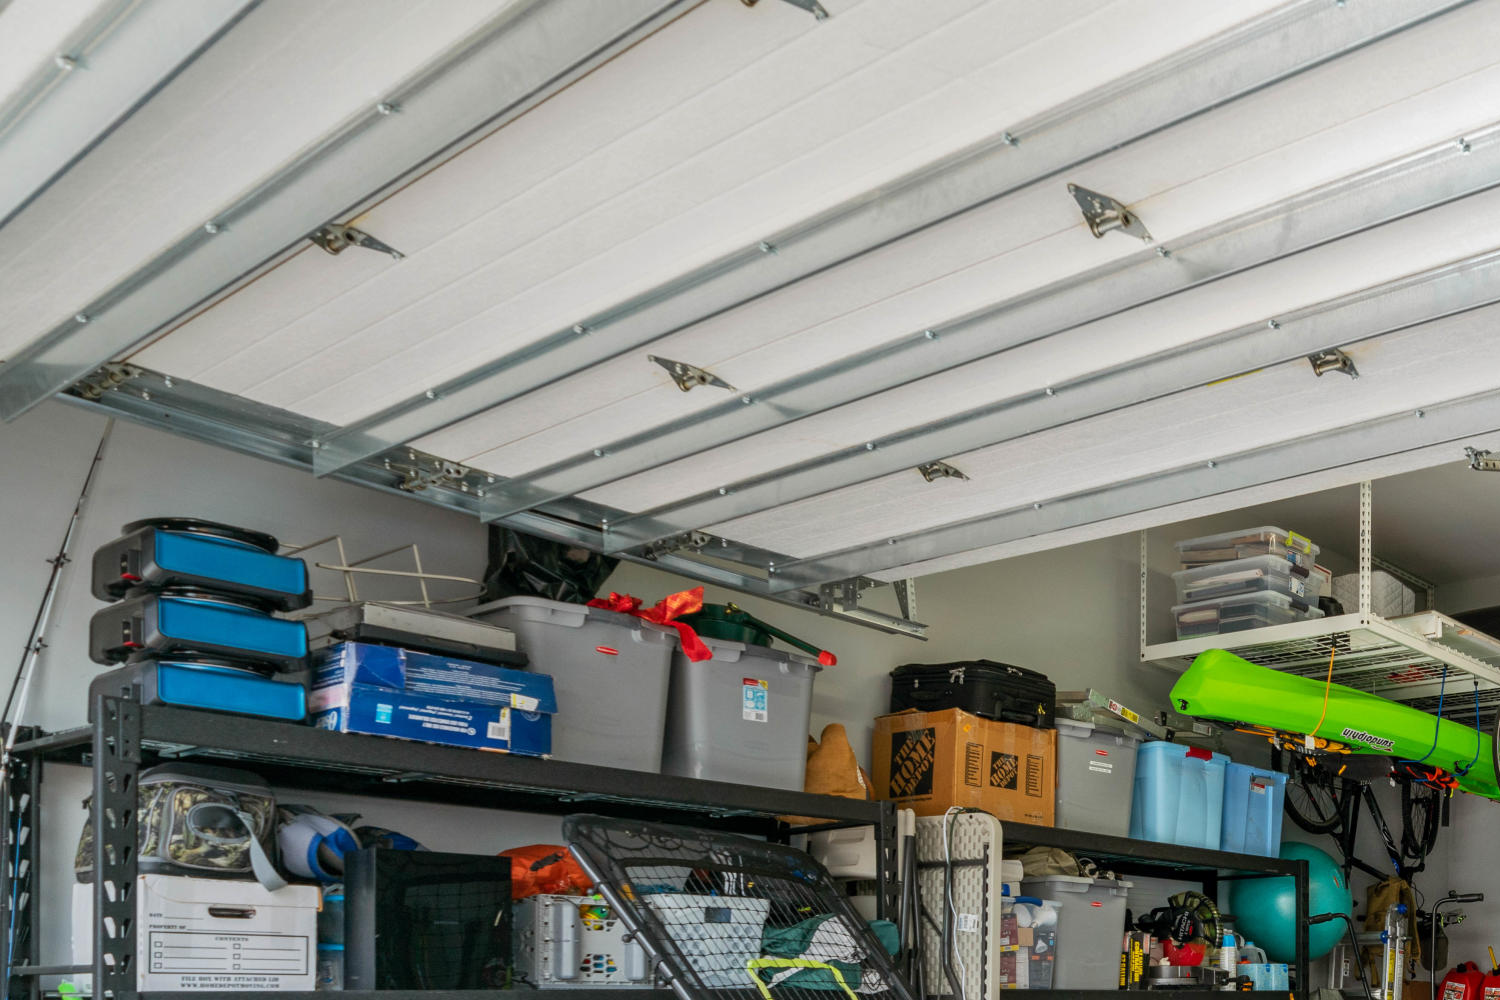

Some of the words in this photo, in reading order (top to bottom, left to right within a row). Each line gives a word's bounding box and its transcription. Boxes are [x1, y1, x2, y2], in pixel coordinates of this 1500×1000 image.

[894, 736, 915, 766] THE
[1342, 728, 1394, 747] sundolphin
[890, 730, 936, 797] HOME
[905, 750, 935, 795] DEPOT
[990, 757, 1018, 787] HOME
[993, 755, 1005, 770] THE
[1000, 768, 1018, 788] DEPOT
